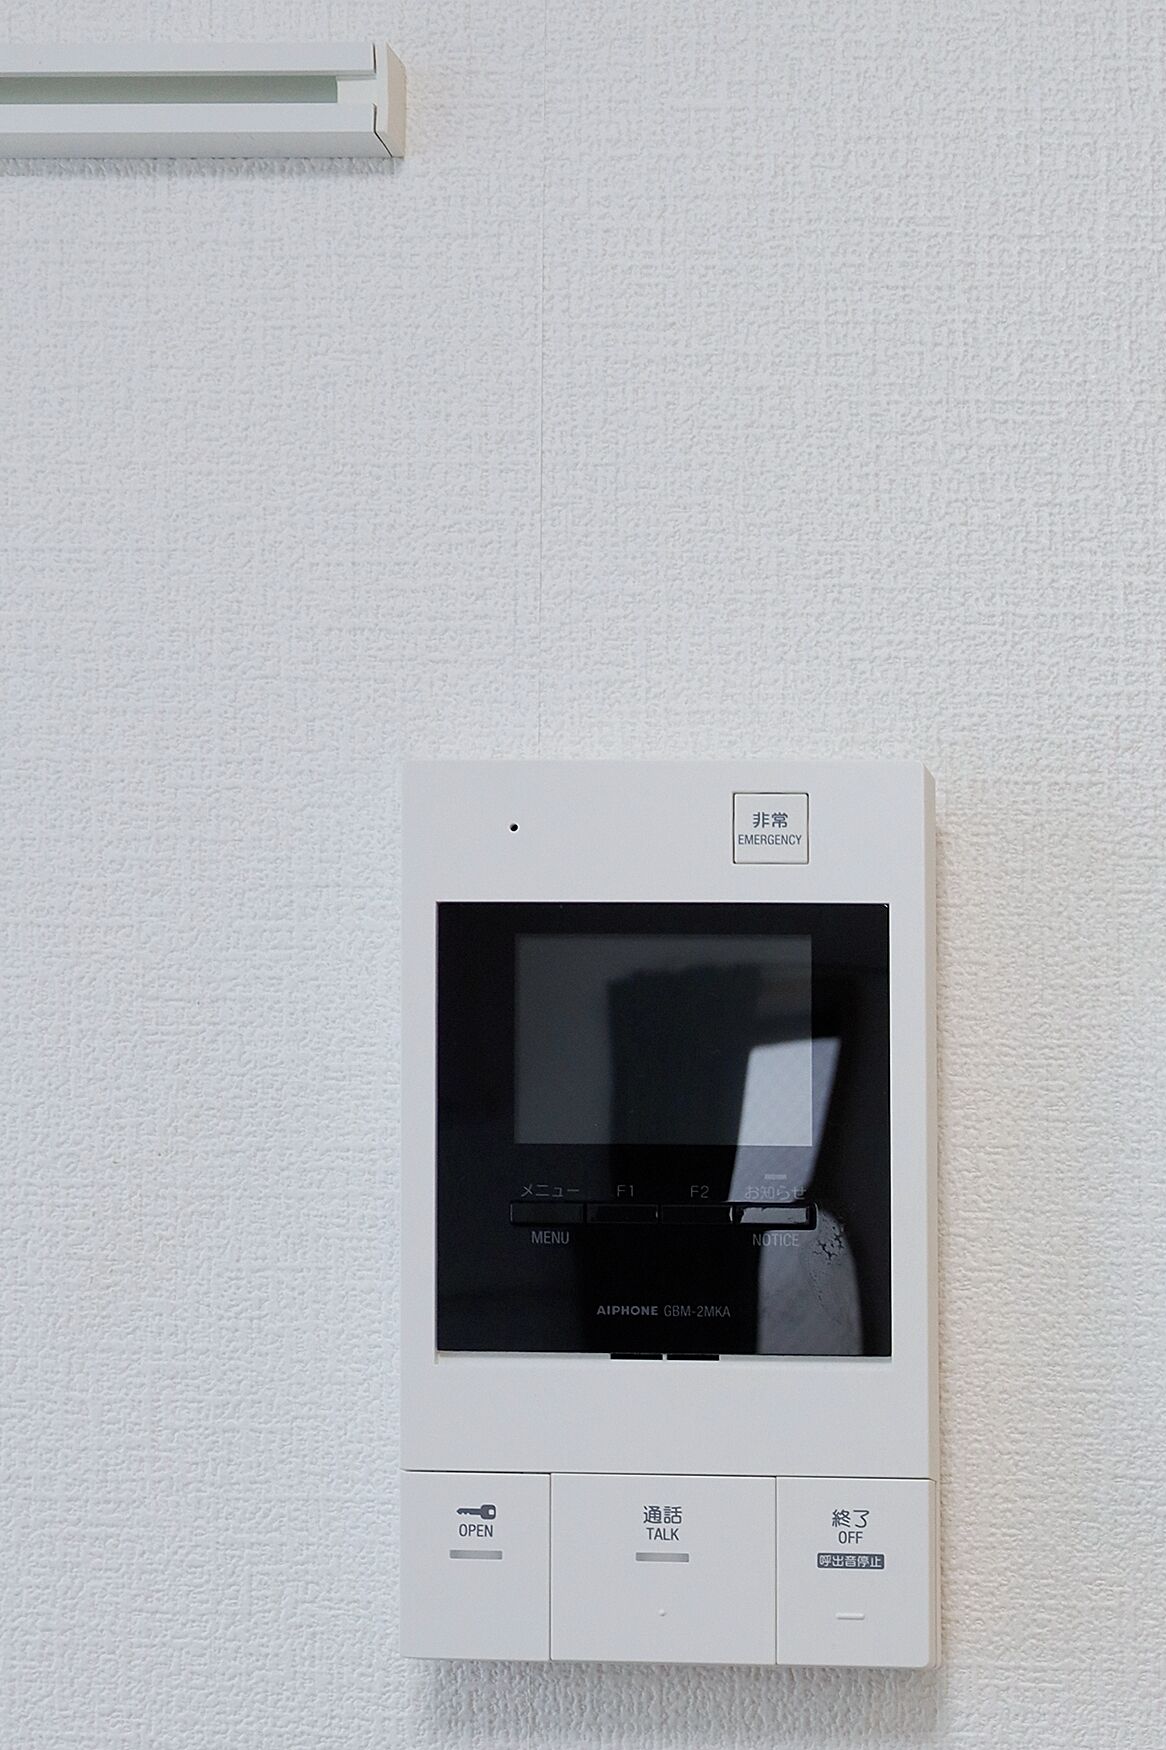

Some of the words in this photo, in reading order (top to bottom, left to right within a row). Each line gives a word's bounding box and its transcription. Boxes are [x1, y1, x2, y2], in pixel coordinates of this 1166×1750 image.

[752, 811, 788, 828] 非常
[738, 833, 802, 845] EMERGENCY
[520, 1184, 580, 1198] メニュー
[616, 1184, 634, 1197] F1
[690, 1185, 710, 1198] F2
[744, 1185, 807, 1200] お知らせ
[531, 1231, 570, 1244] MENU
[752, 1233, 800, 1247] NOTICE
[596, 1305, 659, 1316] AIPHONE
[663, 1305, 731, 1318] GBM-2MKA
[642, 1505, 683, 1525] 通話
[831, 1508, 870, 1528] 終了
[458, 1523, 494, 1538] OPEN
[646, 1527, 680, 1542] TALK
[838, 1530, 864, 1544] OFF
[819, 1554, 882, 1568] 呼出音停止
